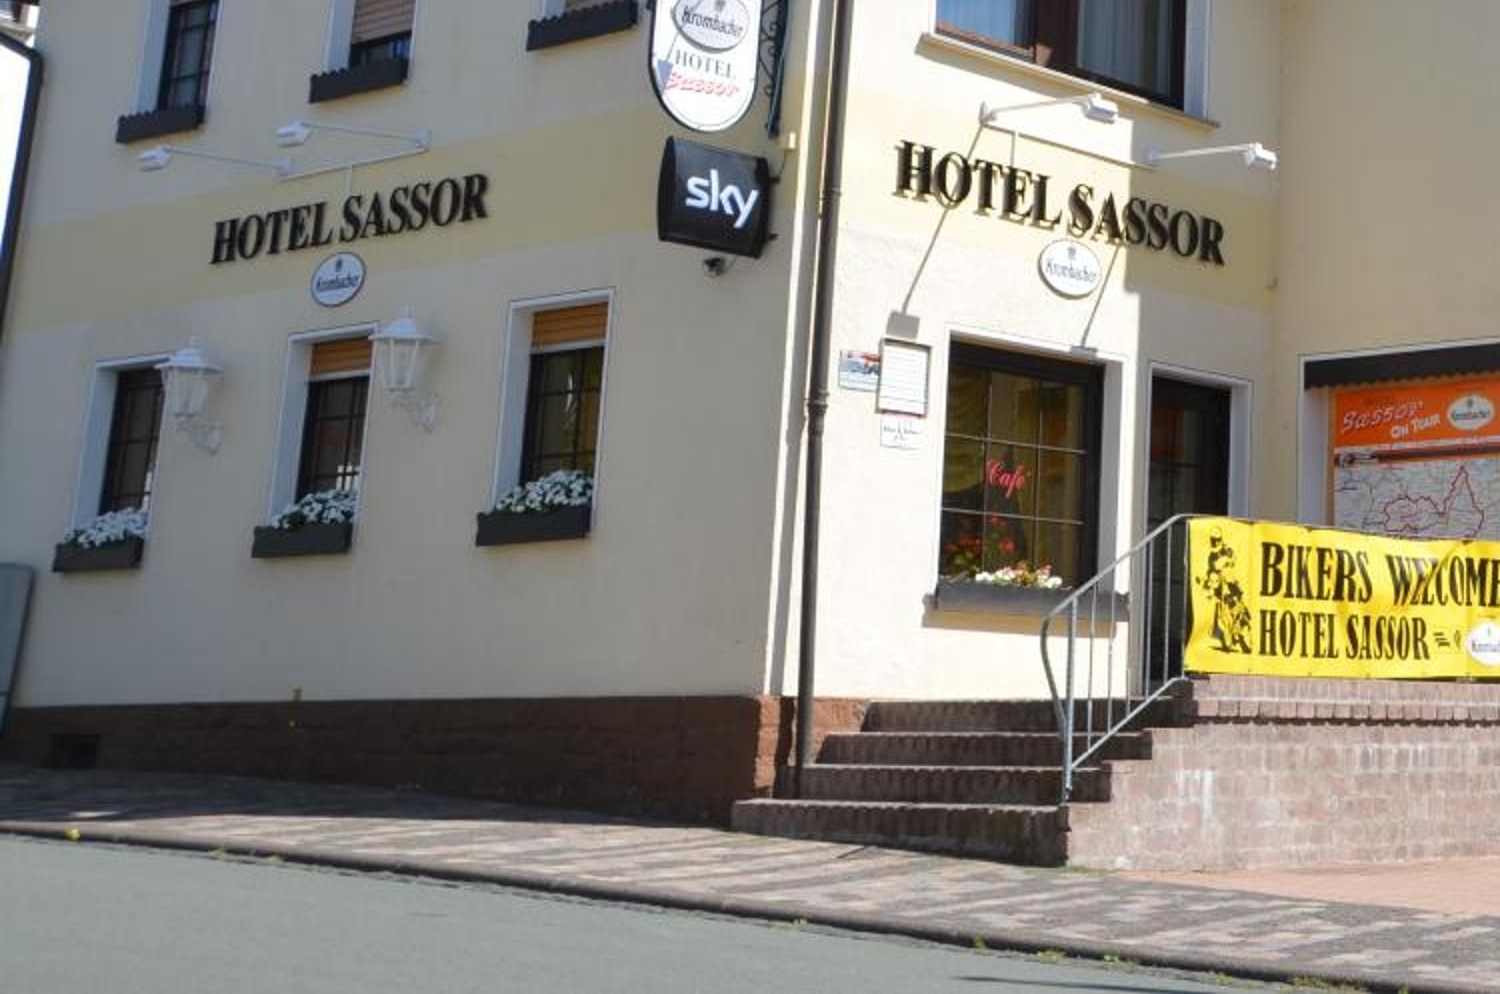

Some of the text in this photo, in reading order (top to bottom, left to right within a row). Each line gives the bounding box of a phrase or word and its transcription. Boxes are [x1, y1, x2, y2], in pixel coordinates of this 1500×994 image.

[674, 49, 737, 80] HOTEL
[208, 173, 490, 265] HOTEL SASSOR
[685, 168, 758, 229] sky
[897, 139, 1226, 266] HOTEL SASSOR
[1259, 542, 1373, 604] BIKERS
[1258, 609, 1431, 661] HOTEL SASSOR
